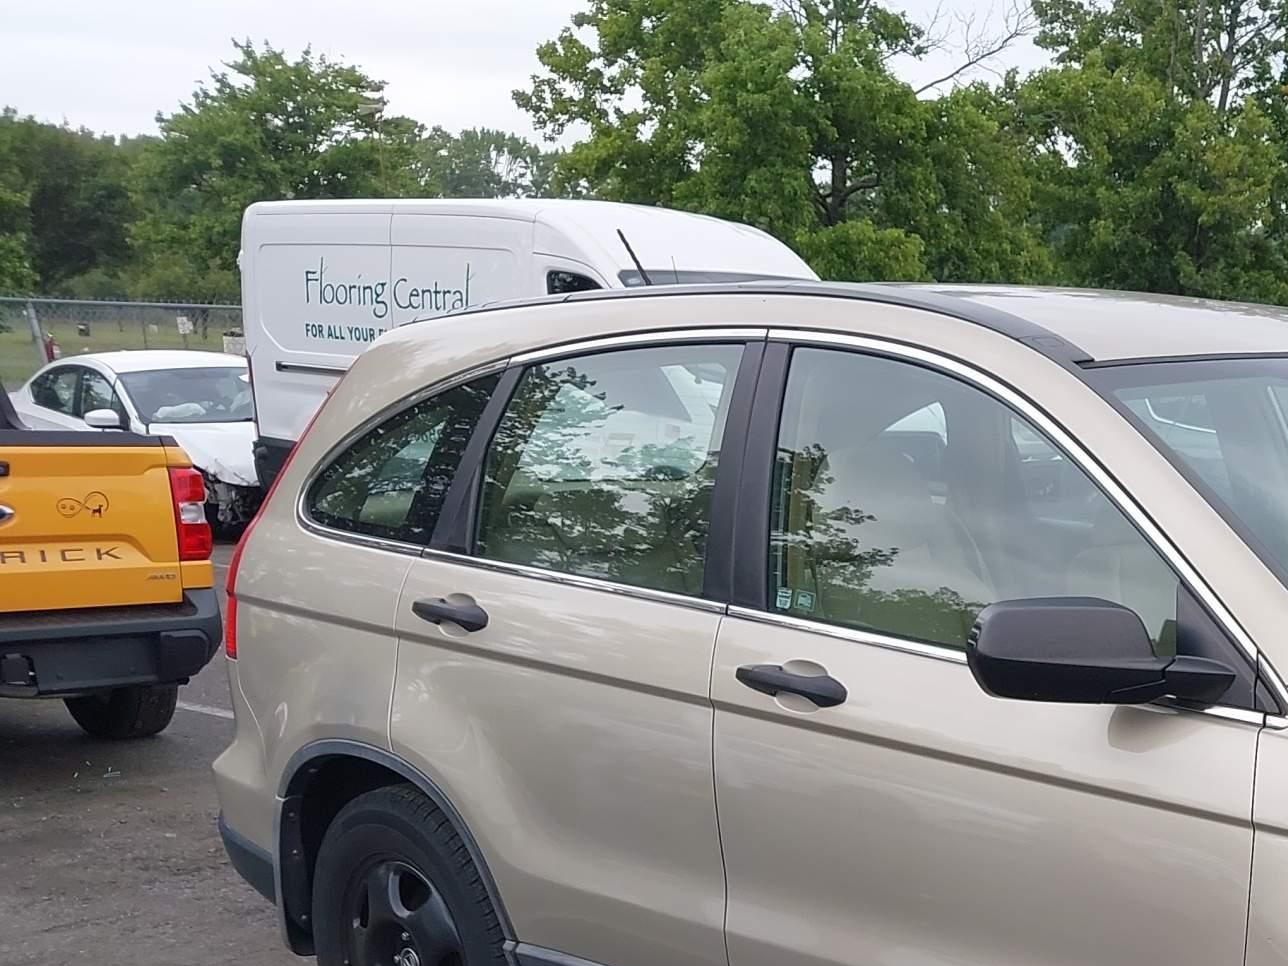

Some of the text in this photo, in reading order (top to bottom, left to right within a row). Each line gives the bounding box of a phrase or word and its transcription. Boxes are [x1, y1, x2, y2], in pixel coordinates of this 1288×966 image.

[305, 257, 470, 318] Flooring Central
[305, 323, 324, 338] FOR
[327, 325, 345, 340] ALL
[347, 326, 376, 342] YOUR
